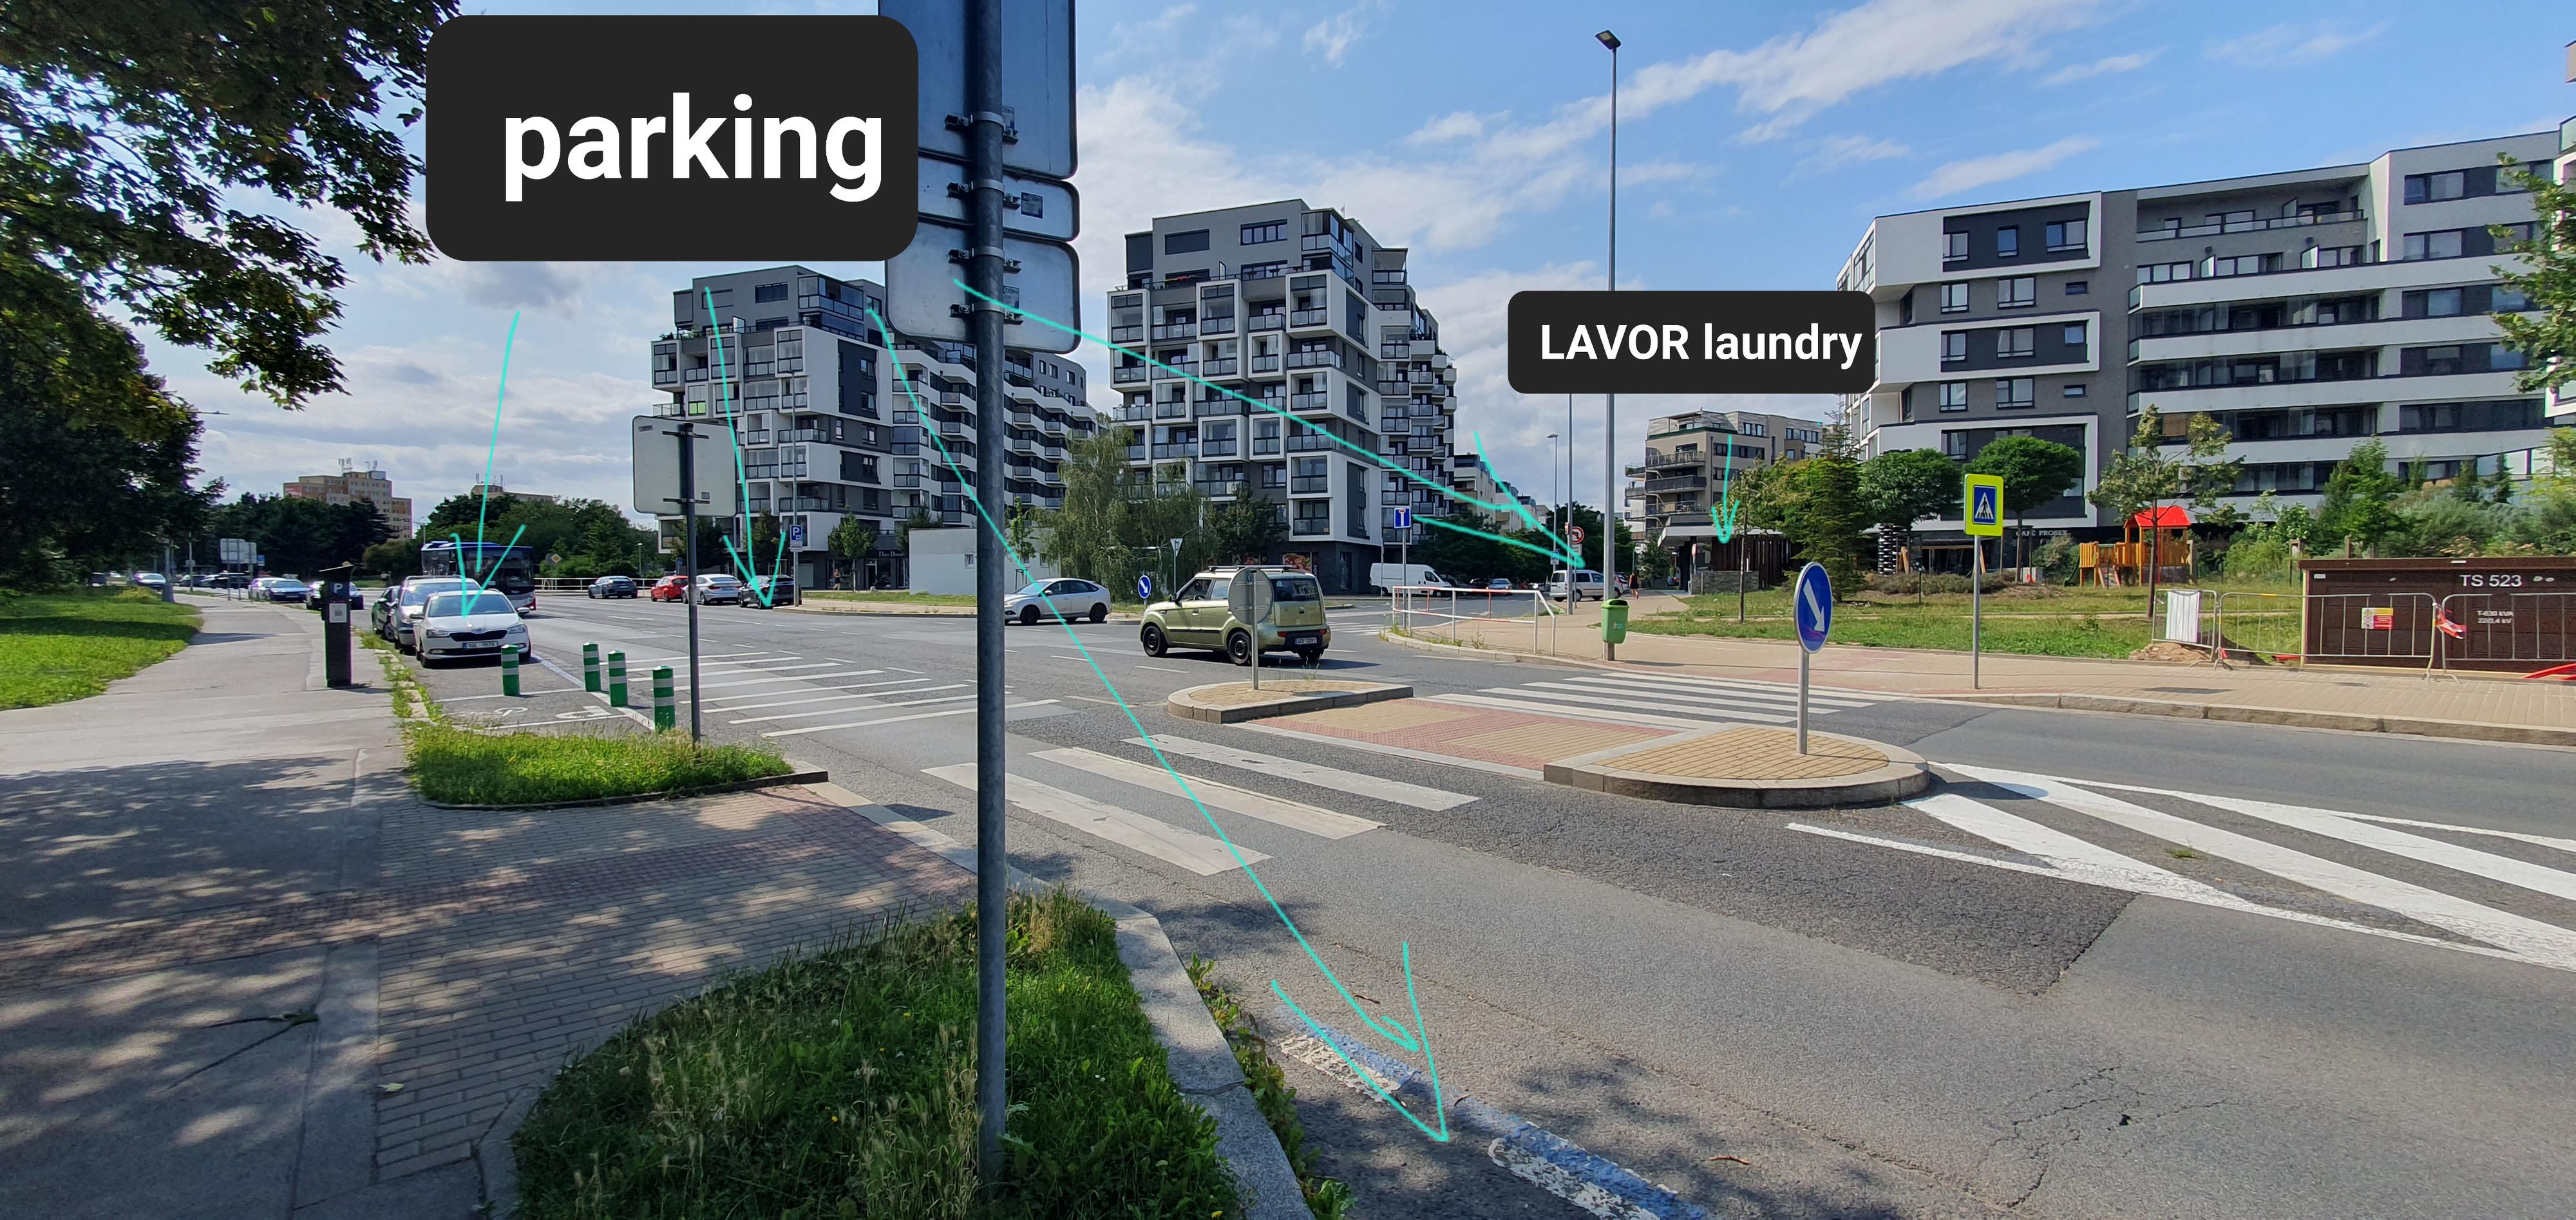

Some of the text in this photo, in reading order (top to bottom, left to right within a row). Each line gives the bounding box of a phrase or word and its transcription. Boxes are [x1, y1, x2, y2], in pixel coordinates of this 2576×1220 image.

[793, 527, 800, 536] P
[2459, 574, 2523, 587] TS 523
[334, 583, 343, 593] P
